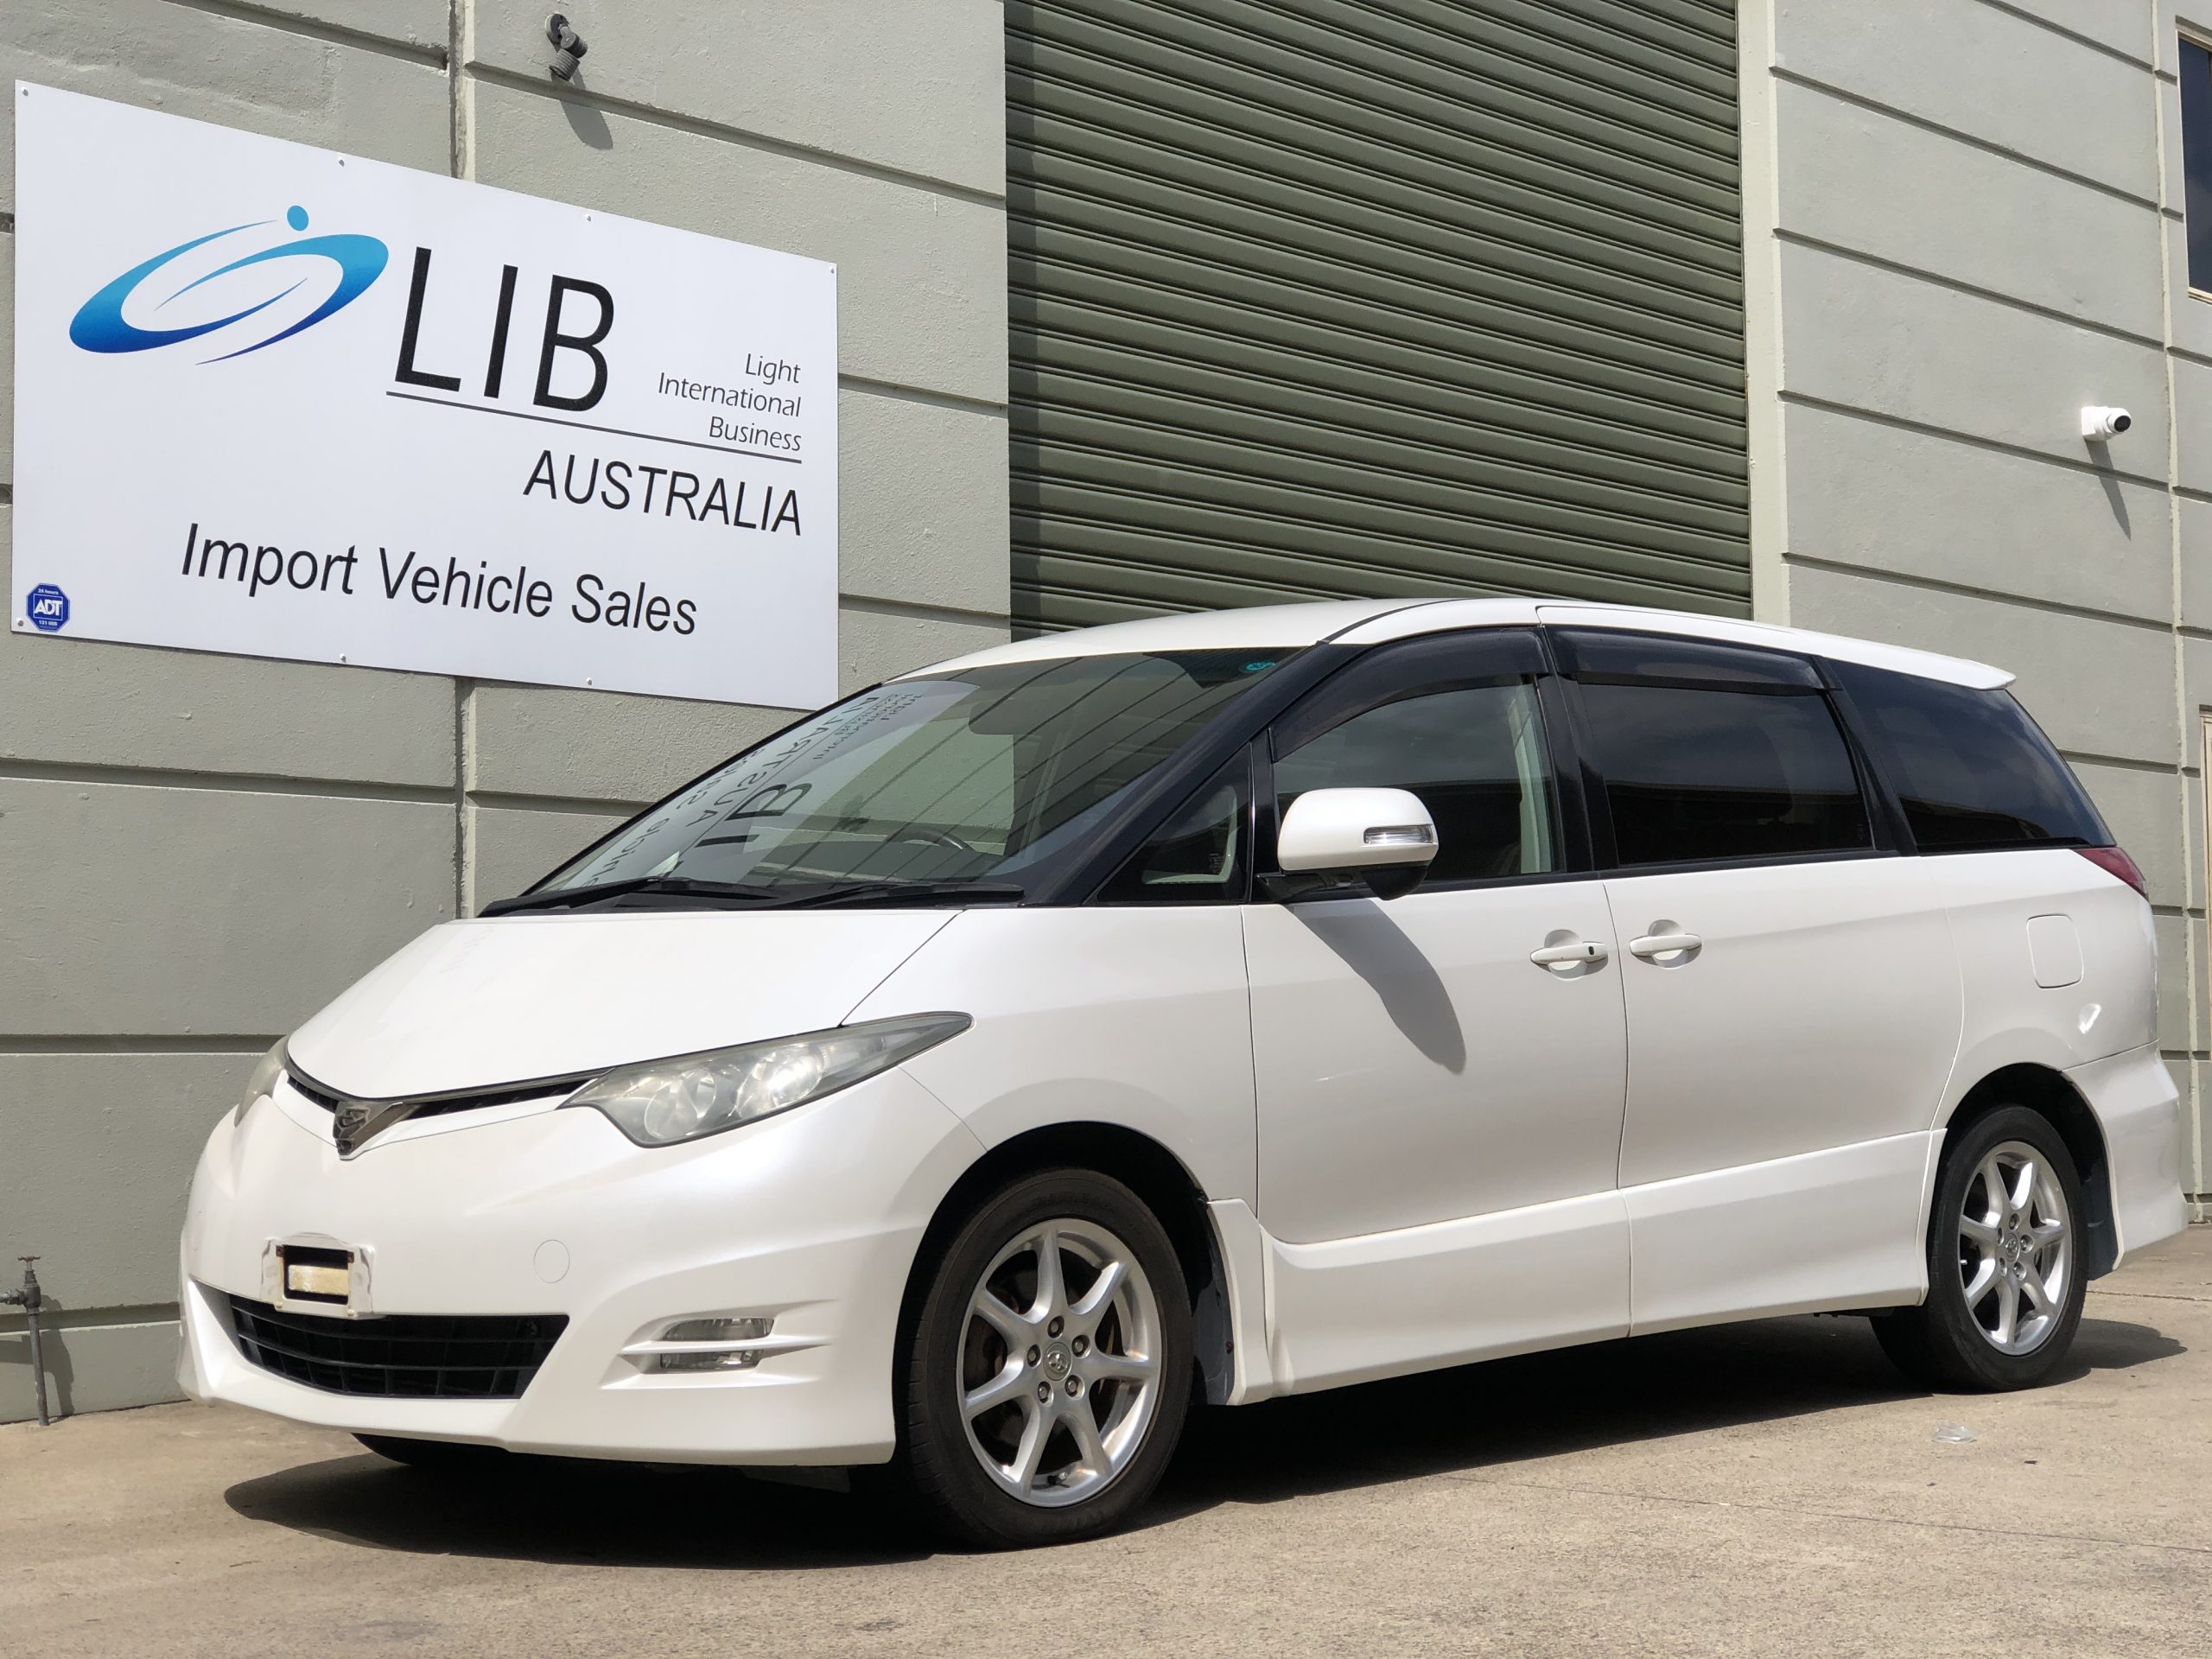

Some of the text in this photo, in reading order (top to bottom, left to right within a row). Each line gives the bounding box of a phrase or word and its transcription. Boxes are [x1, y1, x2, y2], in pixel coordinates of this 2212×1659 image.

[395, 247, 614, 412] LIB
[746, 354, 801, 385] Light
[659, 372, 801, 417] International
[709, 416, 802, 452] Business
[523, 450, 801, 536] AUSTRALIA
[182, 524, 696, 635] Import Vehicle Sales
[35, 599, 63, 616] ADT
